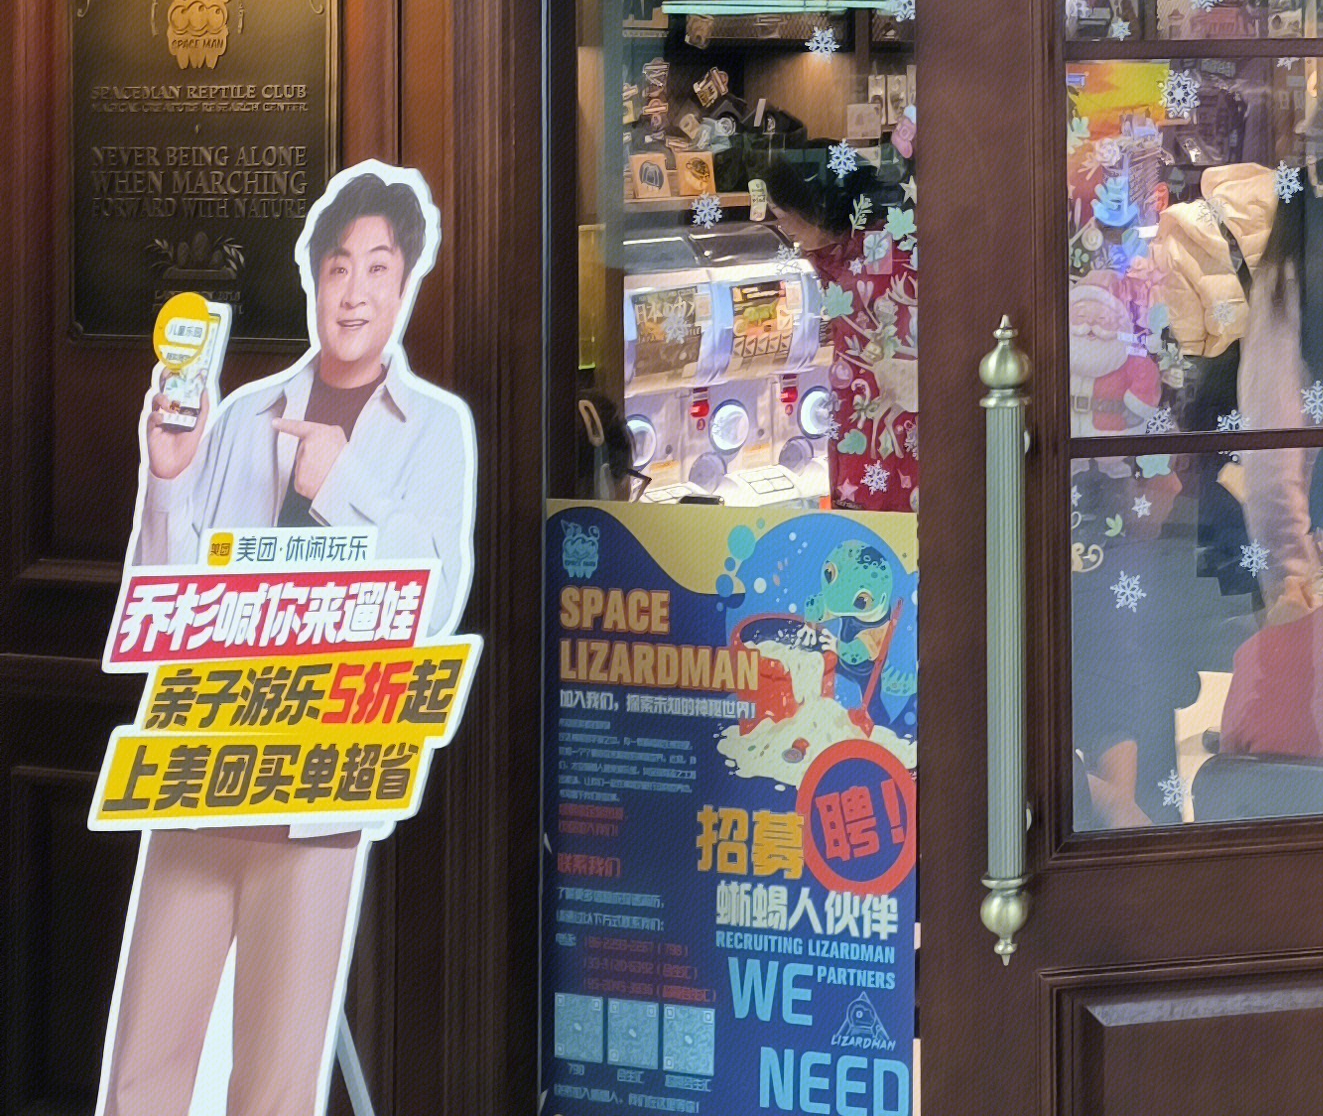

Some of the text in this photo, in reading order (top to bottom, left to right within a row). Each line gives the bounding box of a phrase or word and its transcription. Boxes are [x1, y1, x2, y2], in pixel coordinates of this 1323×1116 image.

[171, 39, 224, 50] SPACE MAN
[91, 84, 308, 100] SPACEMAN REPTILE CLUB
[202, 103, 258, 112] RESEARCH
[262, 102, 308, 112] CENTER
[92, 146, 308, 167] NEVER BEING ALONE
[91, 171, 308, 195] WHEN MARCHING
[92, 197, 308, 219] FORWARD WITH NATURE
[236, 535, 369, 563] 美团·休闲玩乐
[119, 580, 423, 654] 乔杉喊你来遛娃
[559, 585, 671, 635] SPACE
[559, 639, 760, 692] LIZARDMAN
[145, 659, 463, 730] 亲子游乐5折起
[102, 742, 419, 813] 上美团买单超省
[696, 804, 805, 880] 招募
[715, 879, 900, 940] 蜥蜴人伙伴
[715, 930, 803, 955] RECRUITING
[808, 939, 895, 964] LIZARDMAN
[727, 956, 814, 1026] WE
[817, 966, 896, 990] PARTNERS
[831, 1034, 897, 1051] LIZARDMAN
[759, 1046, 911, 1116] NEED
